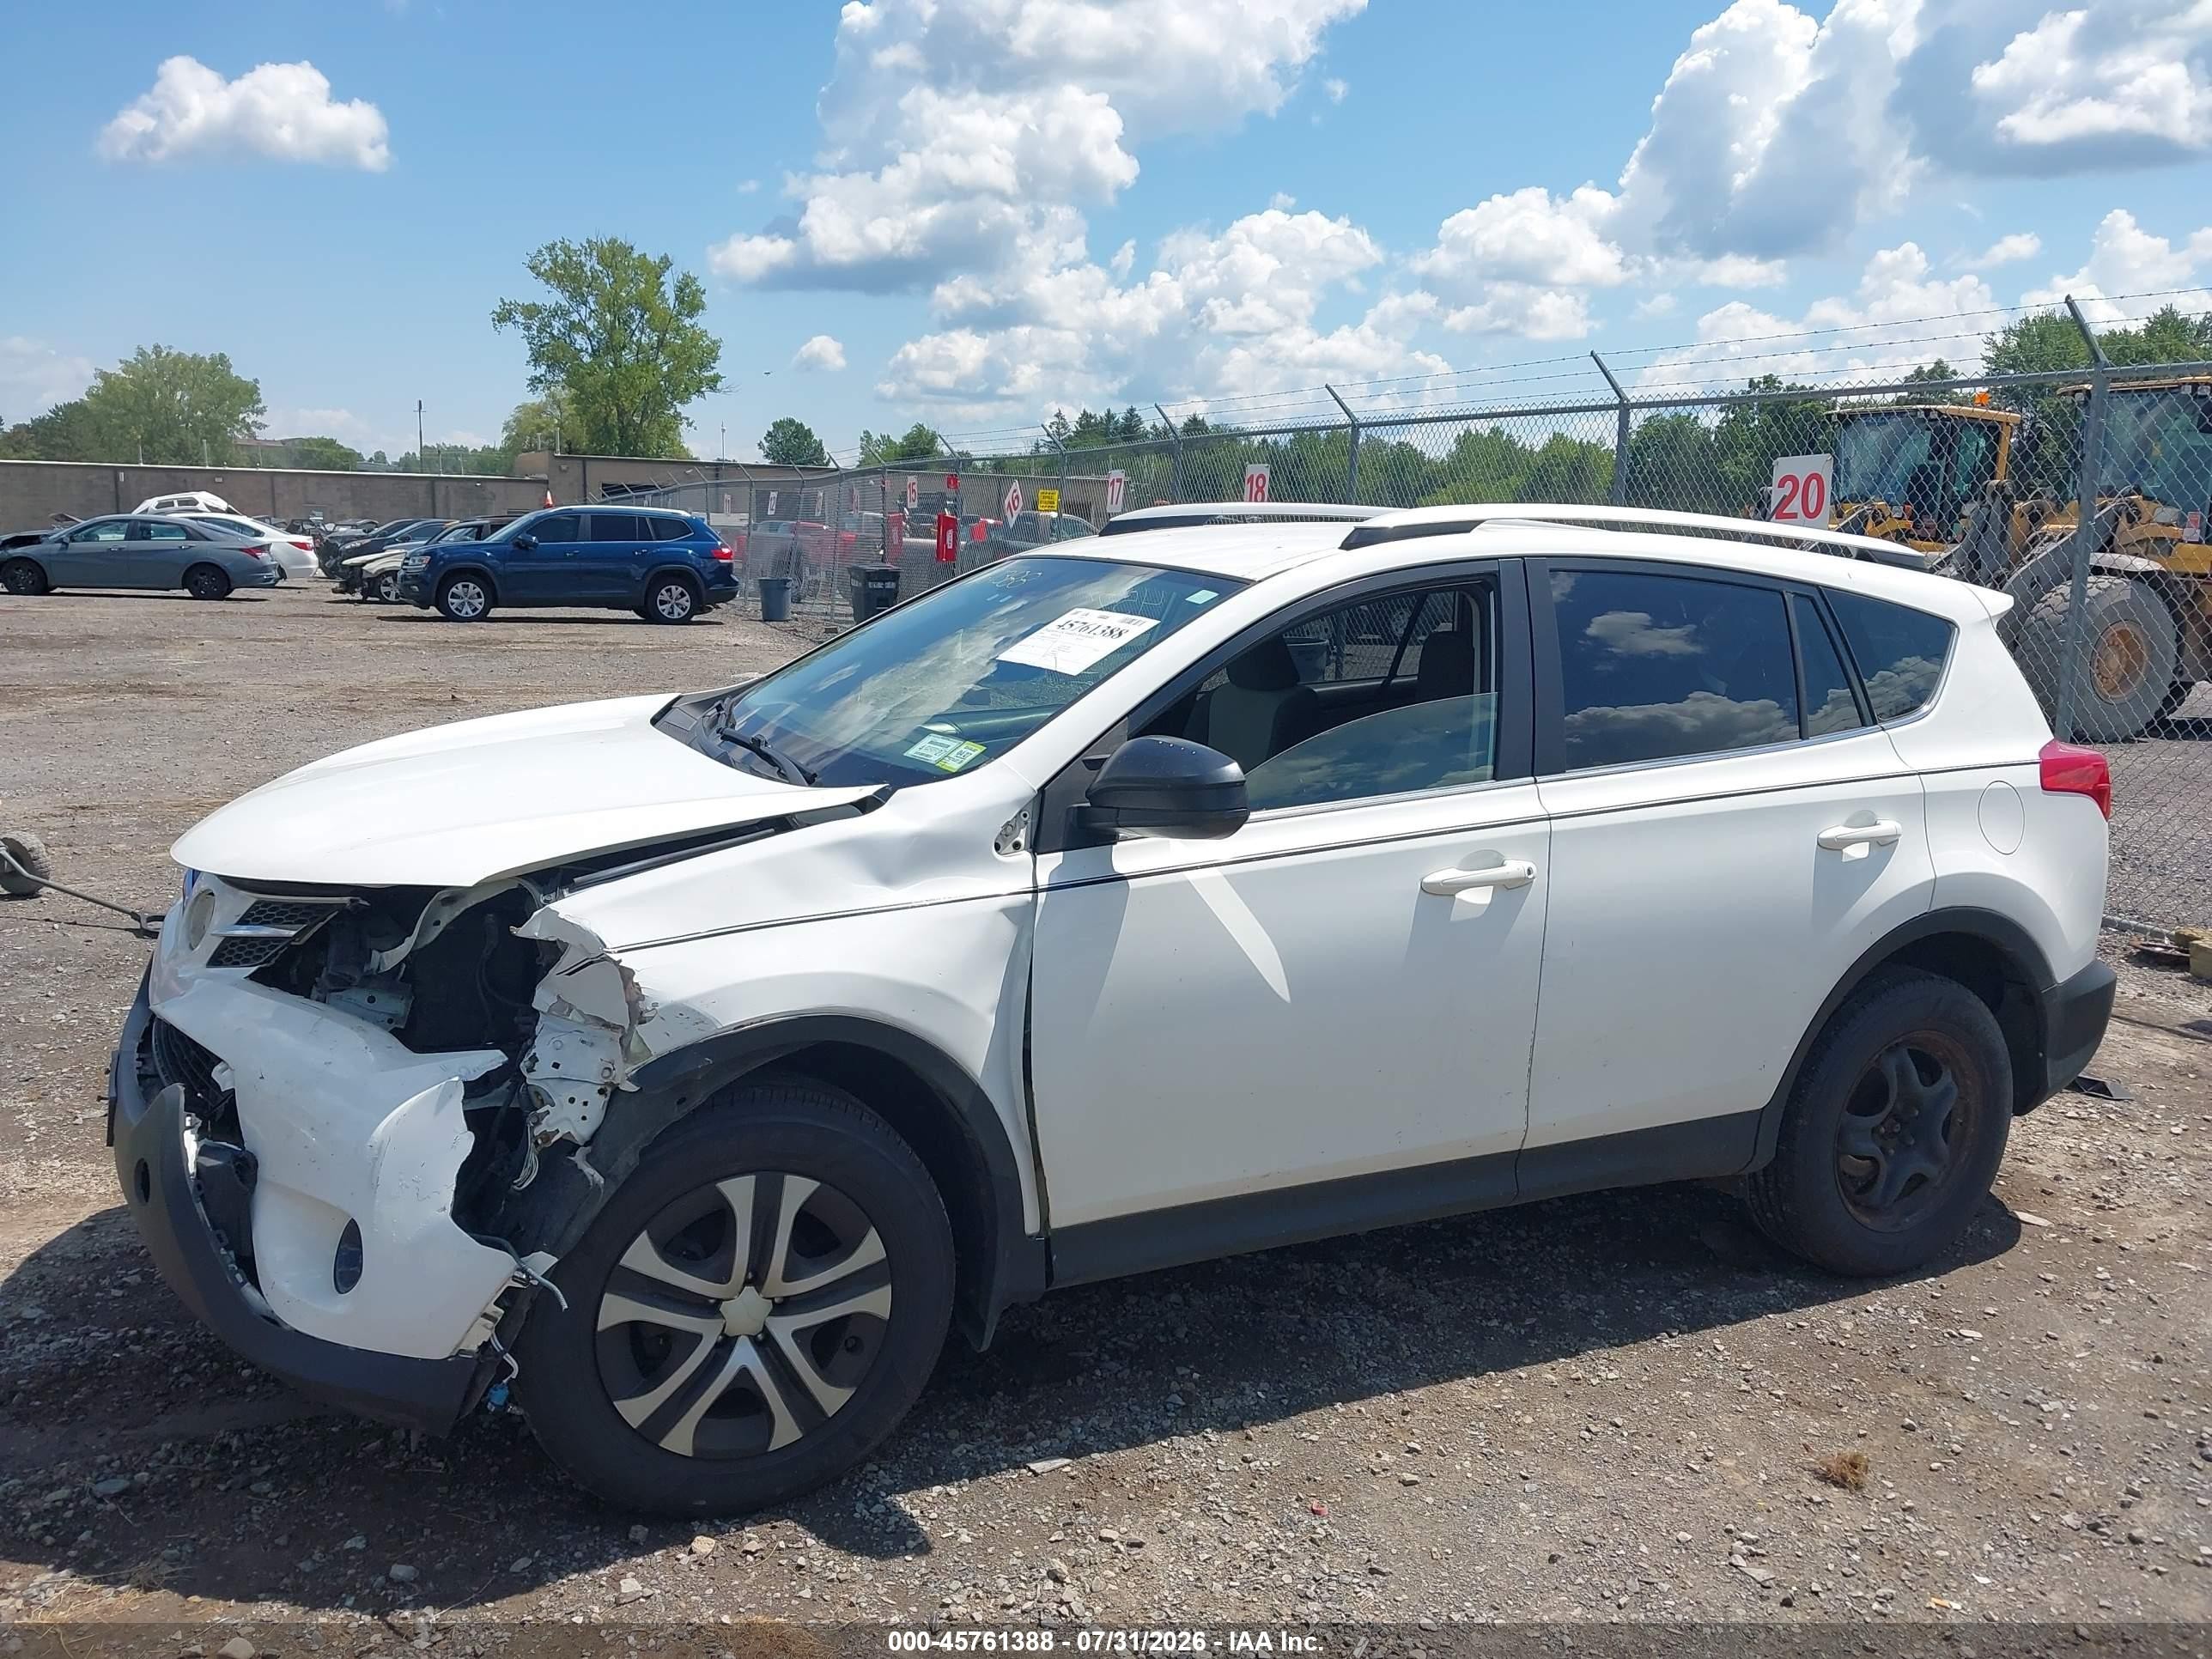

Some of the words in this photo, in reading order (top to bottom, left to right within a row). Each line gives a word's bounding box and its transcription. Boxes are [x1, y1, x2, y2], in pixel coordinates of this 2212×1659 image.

[908, 482, 917, 502] 15
[1109, 477, 1123, 505] 17
[1247, 473, 1267, 501] 18
[1775, 472, 1826, 520] 20
[1006, 489, 1020, 519] 16
[1056, 619, 1129, 639] 45761388
